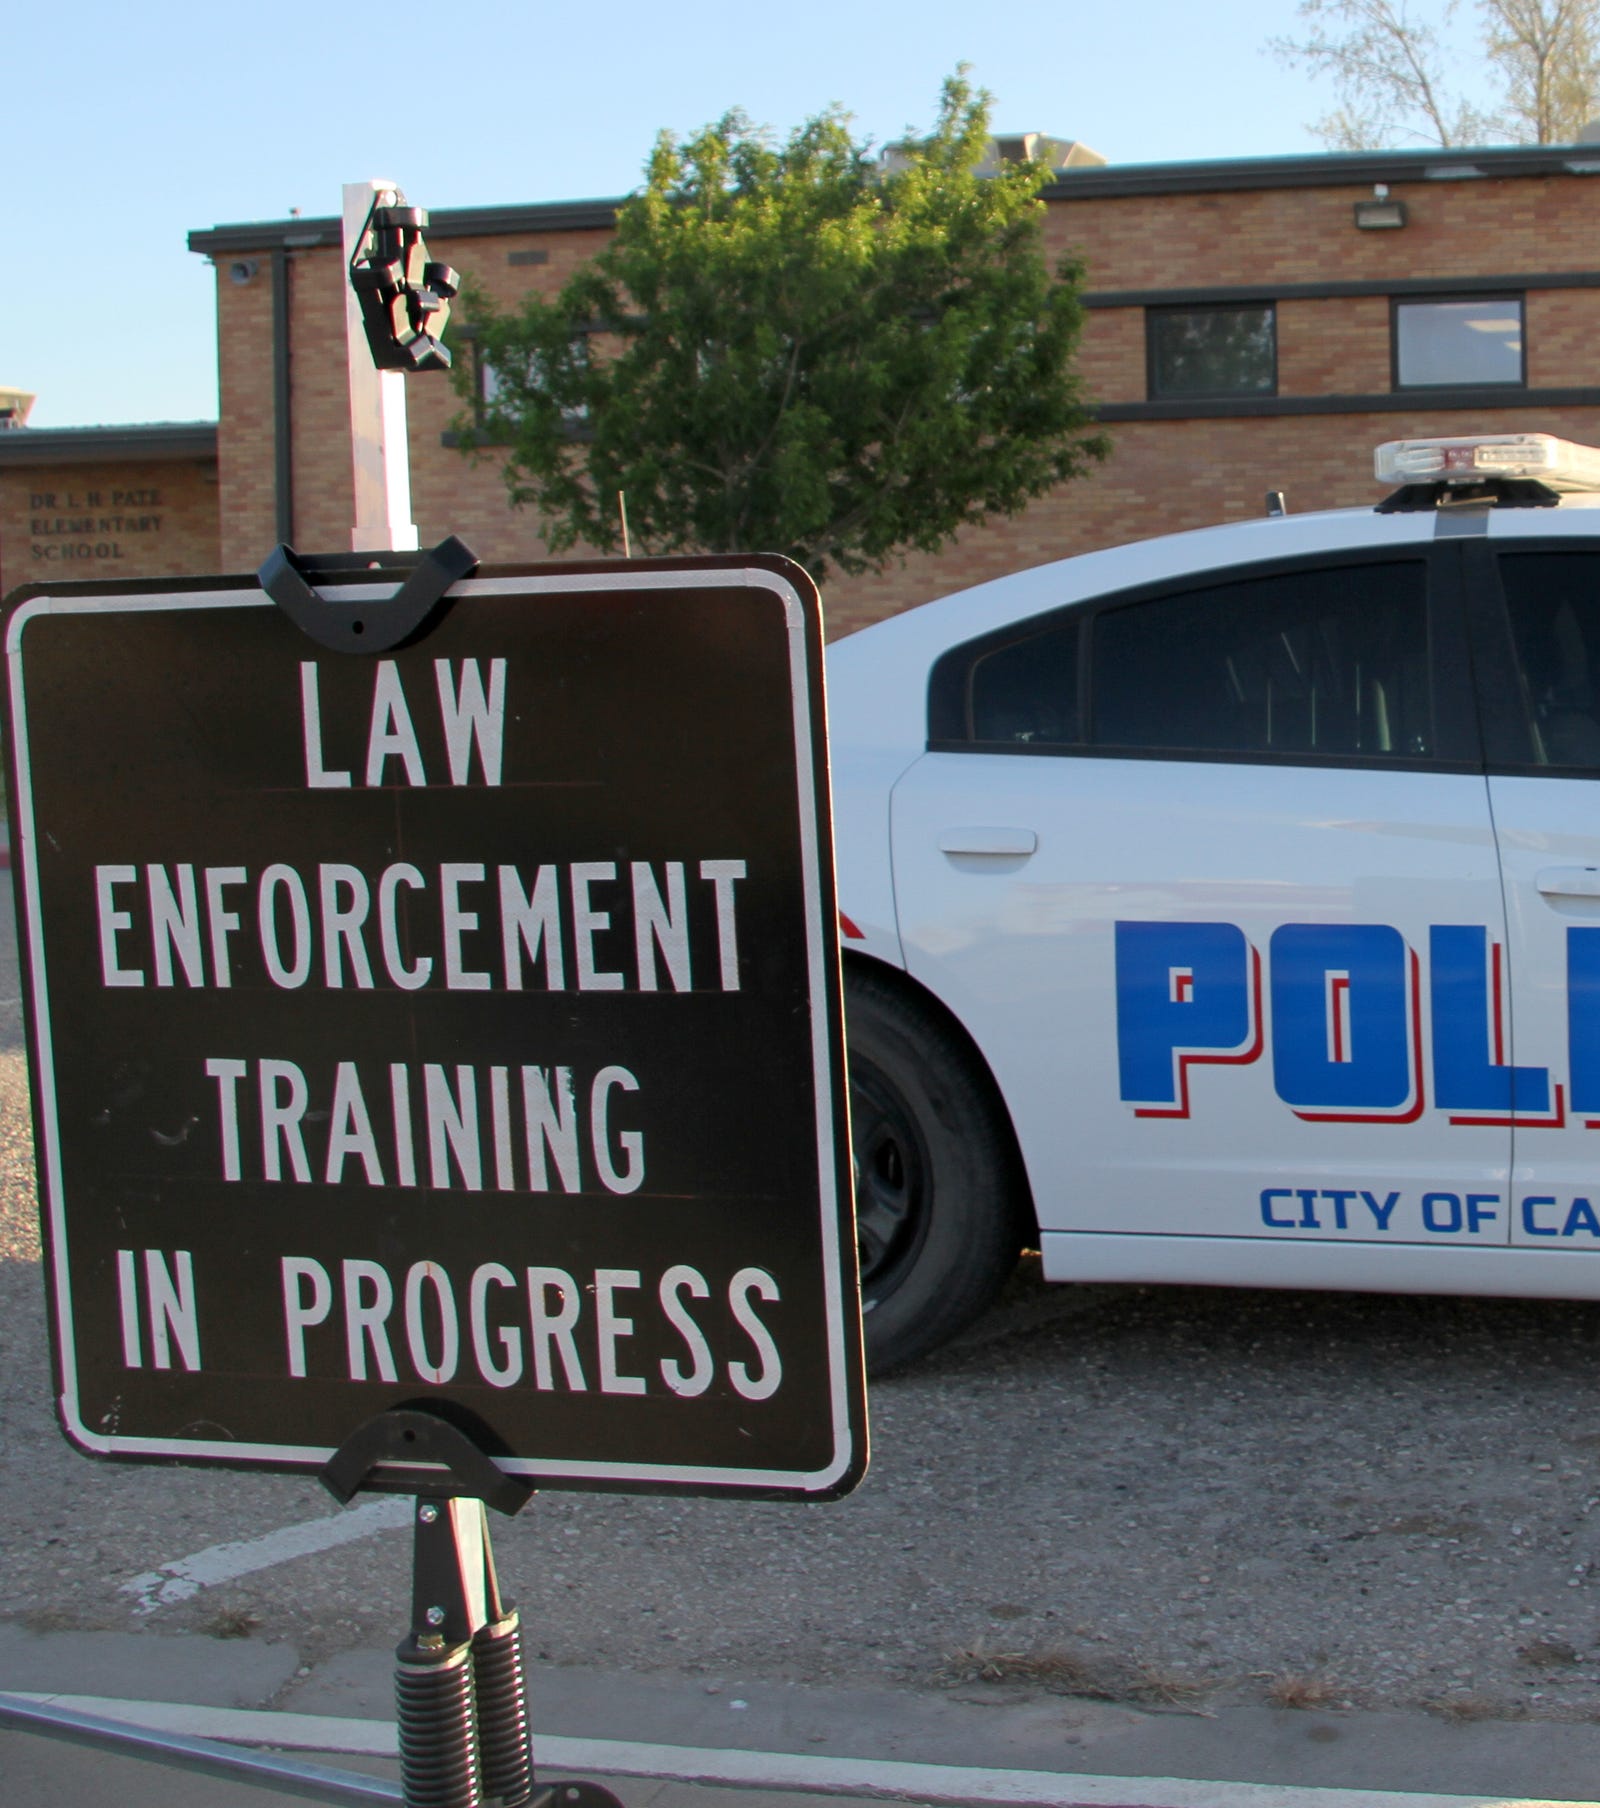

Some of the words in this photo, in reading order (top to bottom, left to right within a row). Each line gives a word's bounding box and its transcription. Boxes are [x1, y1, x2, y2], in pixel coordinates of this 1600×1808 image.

[31, 492, 56, 509] DR
[67, 492, 79, 507] L
[87, 491, 100, 506] H
[112, 488, 161, 507] PATE
[31, 515, 161, 535] ELEMENTARY
[31, 542, 123, 560] SCHOOL
[300, 658, 507, 787] LAW
[94, 859, 747, 992] ENFORCEMENT
[206, 1058, 645, 1194] TRAINING
[1259, 1188, 1400, 1230] CITY
[1421, 1192, 1500, 1234] OF
[116, 1248, 201, 1371] IN
[281, 1255, 783, 1401] PROGRESS
